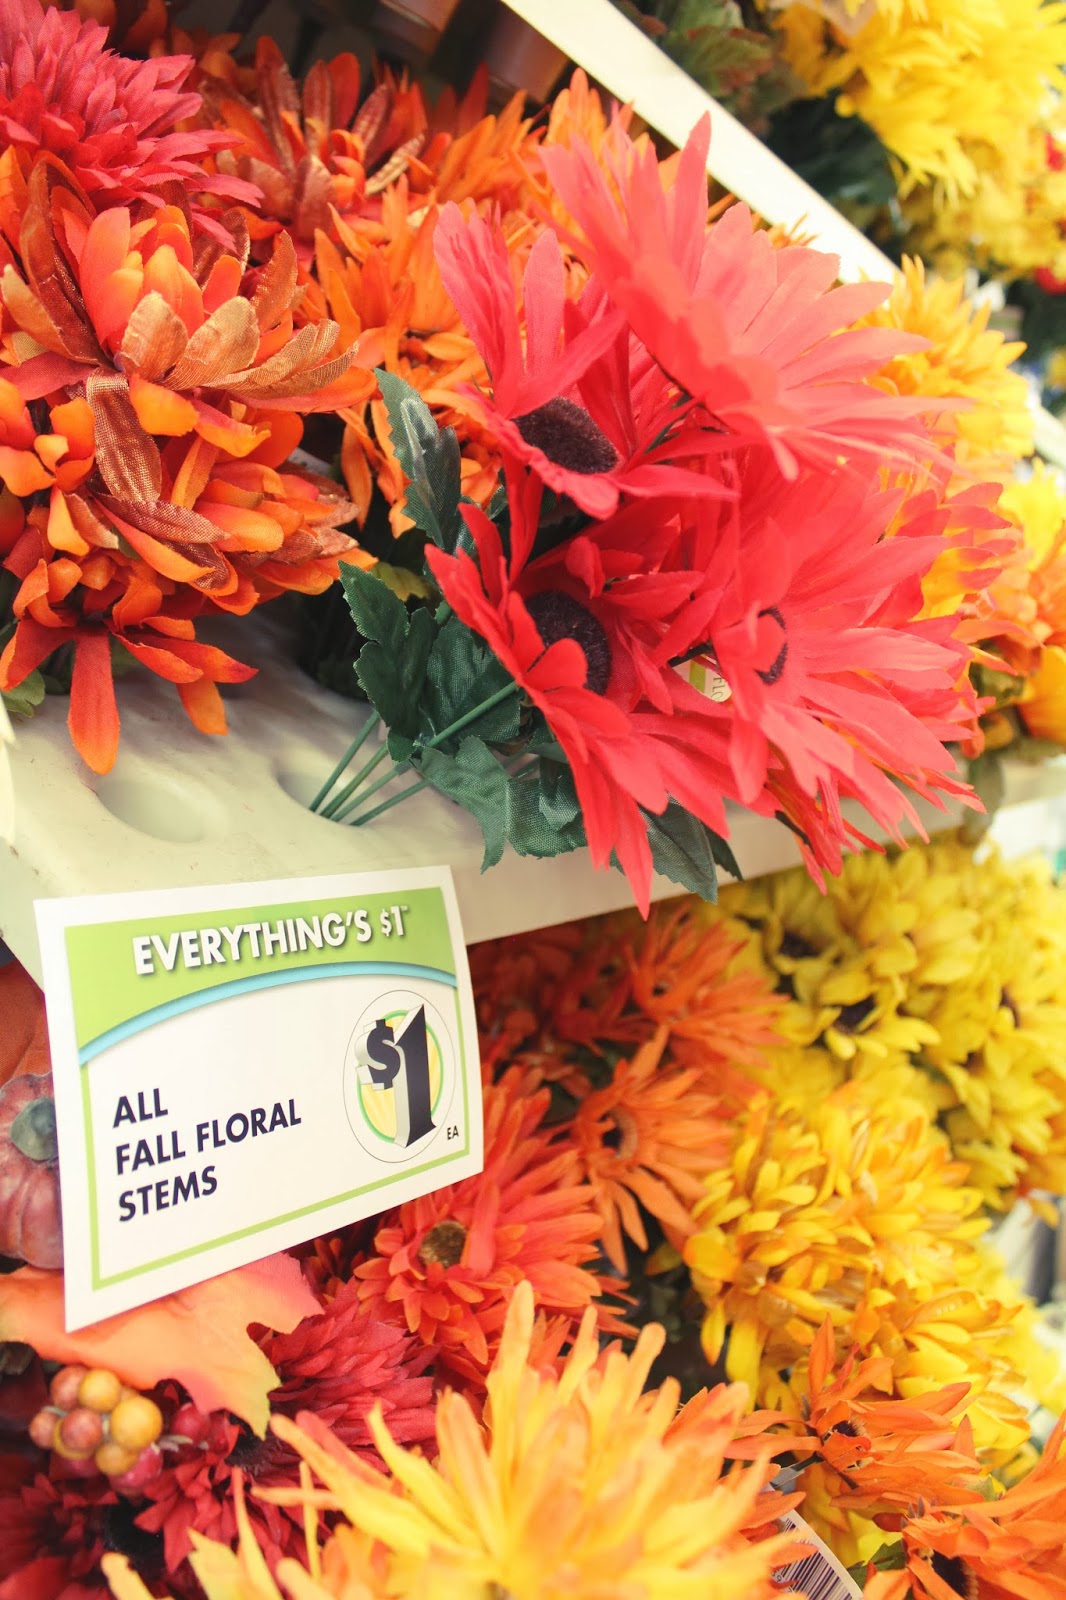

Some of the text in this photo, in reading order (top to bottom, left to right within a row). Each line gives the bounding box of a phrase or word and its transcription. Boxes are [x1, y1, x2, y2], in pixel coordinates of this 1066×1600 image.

[132, 909, 372, 975] EVERYTHING'S
[362, 1003, 438, 1148] $1
[113, 1087, 169, 1128] ALL
[115, 1098, 302, 1175] FALL FLORAL
[446, 1125, 460, 1141] EA
[118, 1165, 218, 1222] STEMS
